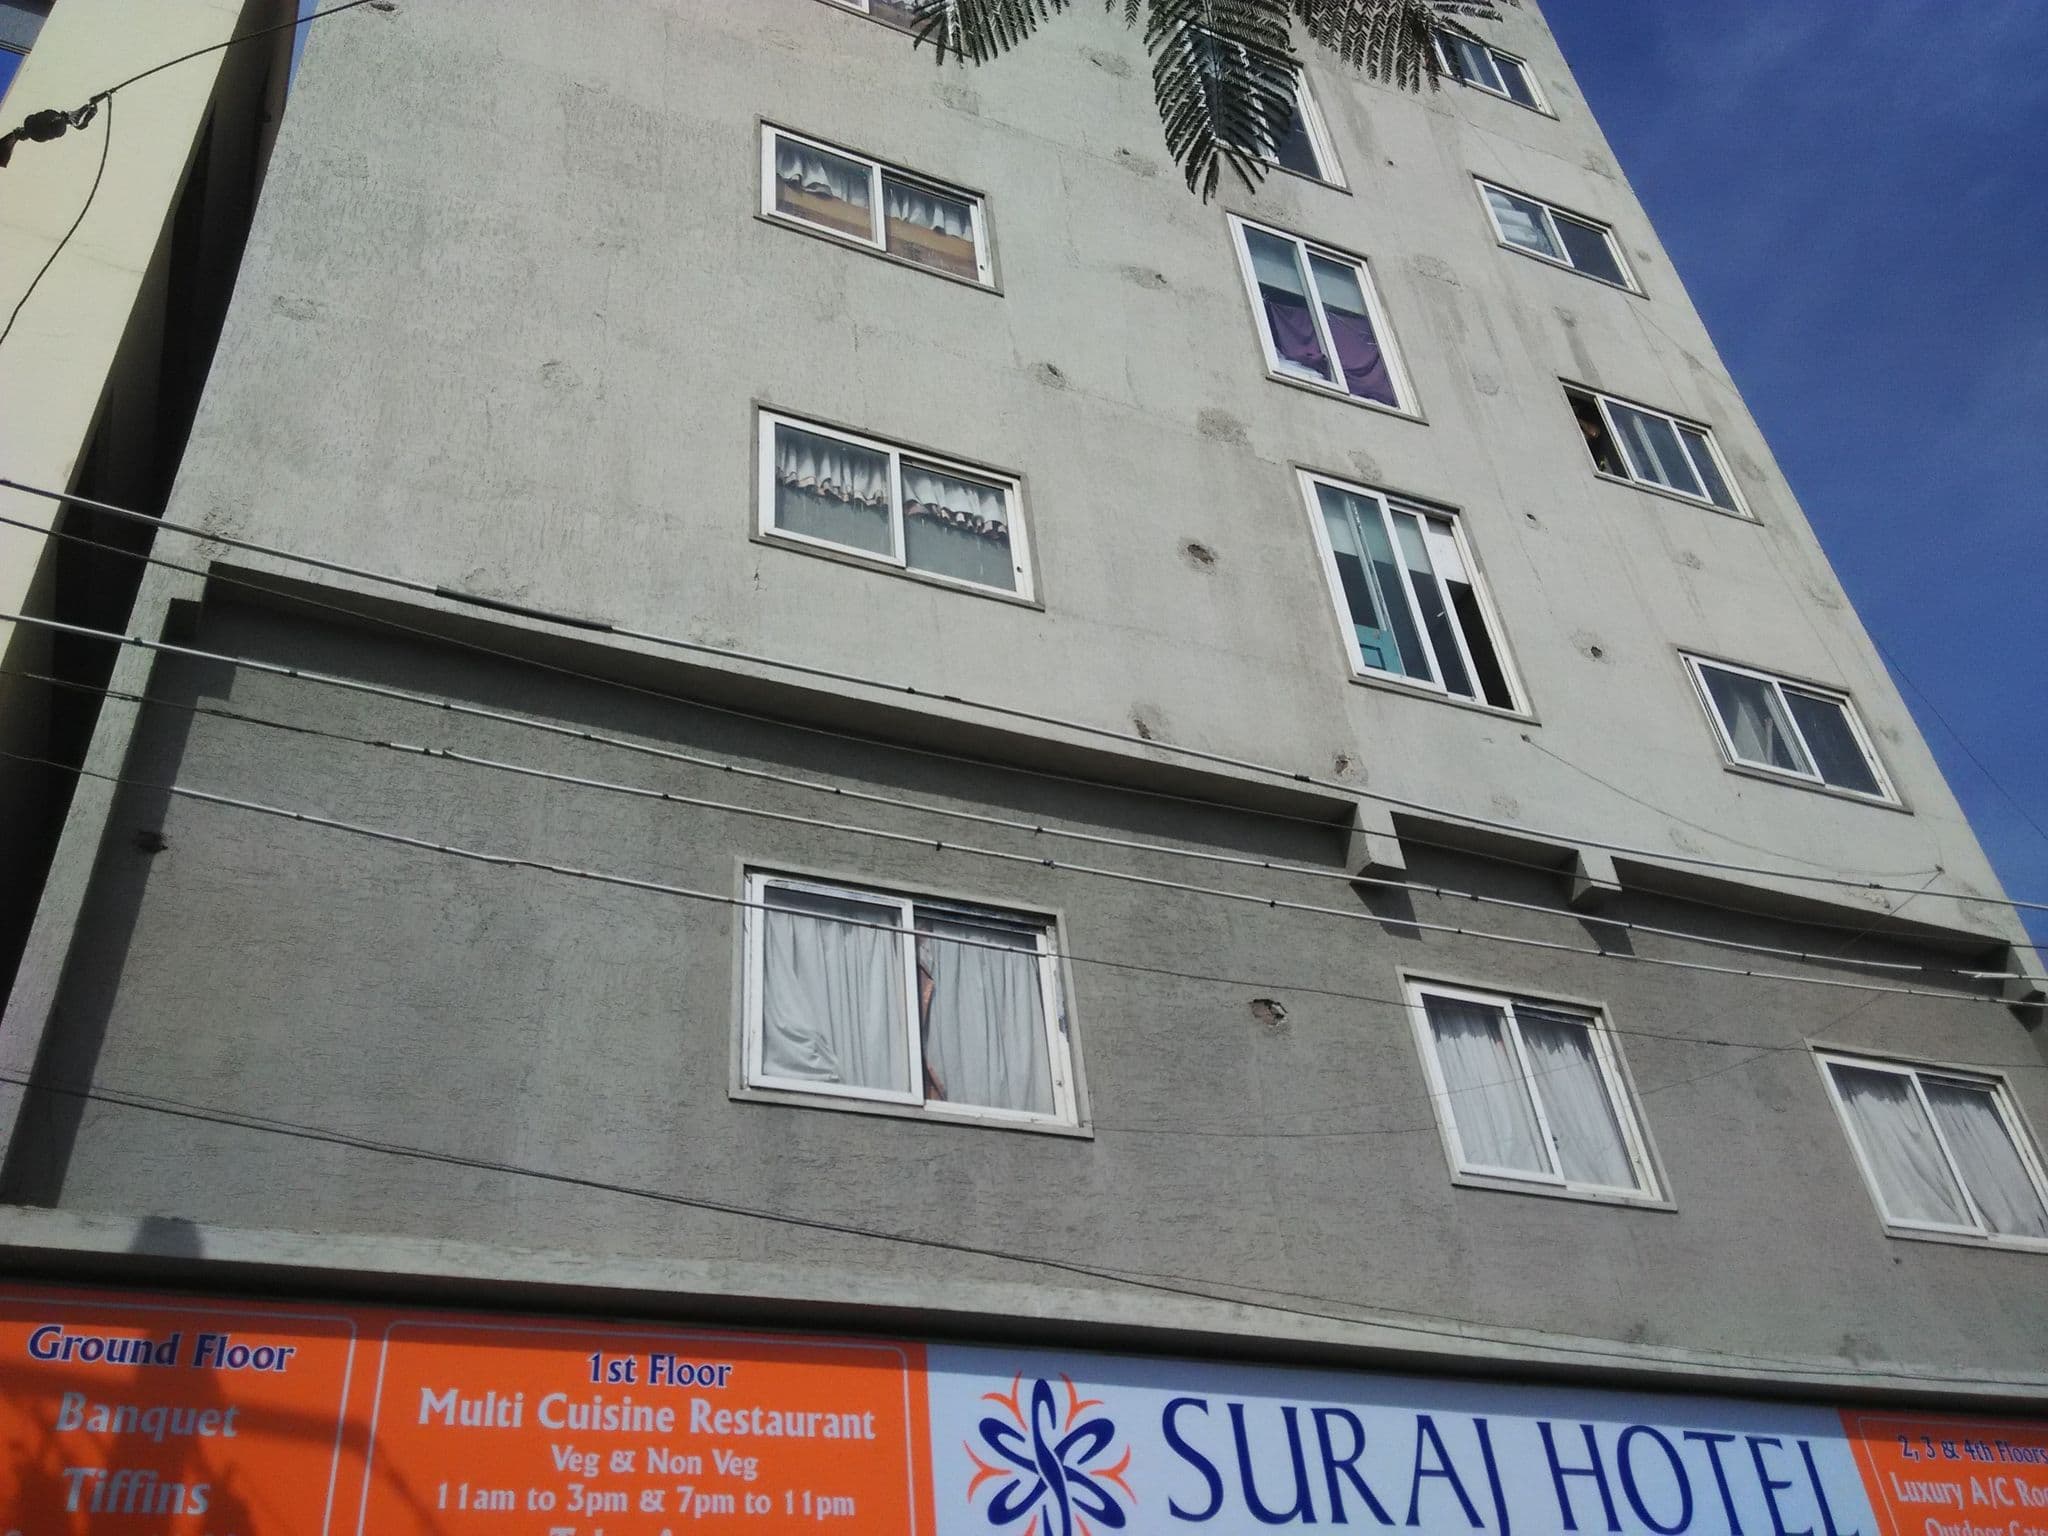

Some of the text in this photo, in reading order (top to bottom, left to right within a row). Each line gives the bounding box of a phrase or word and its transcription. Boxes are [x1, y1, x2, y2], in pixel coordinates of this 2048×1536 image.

[29, 1325, 296, 1372] Ground Floor
[589, 1351, 732, 1388] 1st Floor
[56, 1391, 239, 1442] Banquet
[418, 1387, 876, 1440] Multi Cuisine Restaurant
[551, 1444, 758, 1481] Veg & Non Veg
[1161, 1396, 1860, 1536] SURAJ HOTEL
[1920, 1436, 1937, 1459] 3
[1940, 1439, 1960, 1460] &
[1963, 1438, 1994, 1462] 4th
[1994, 1440, 2048, 1464] Floors
[63, 1467, 210, 1515] Tiffins
[437, 1480, 855, 1521] 11am to 3pm & 7pm to 11pm
[1889, 1471, 1964, 1511] Luxury
[1970, 1475, 2014, 1510] A/C
